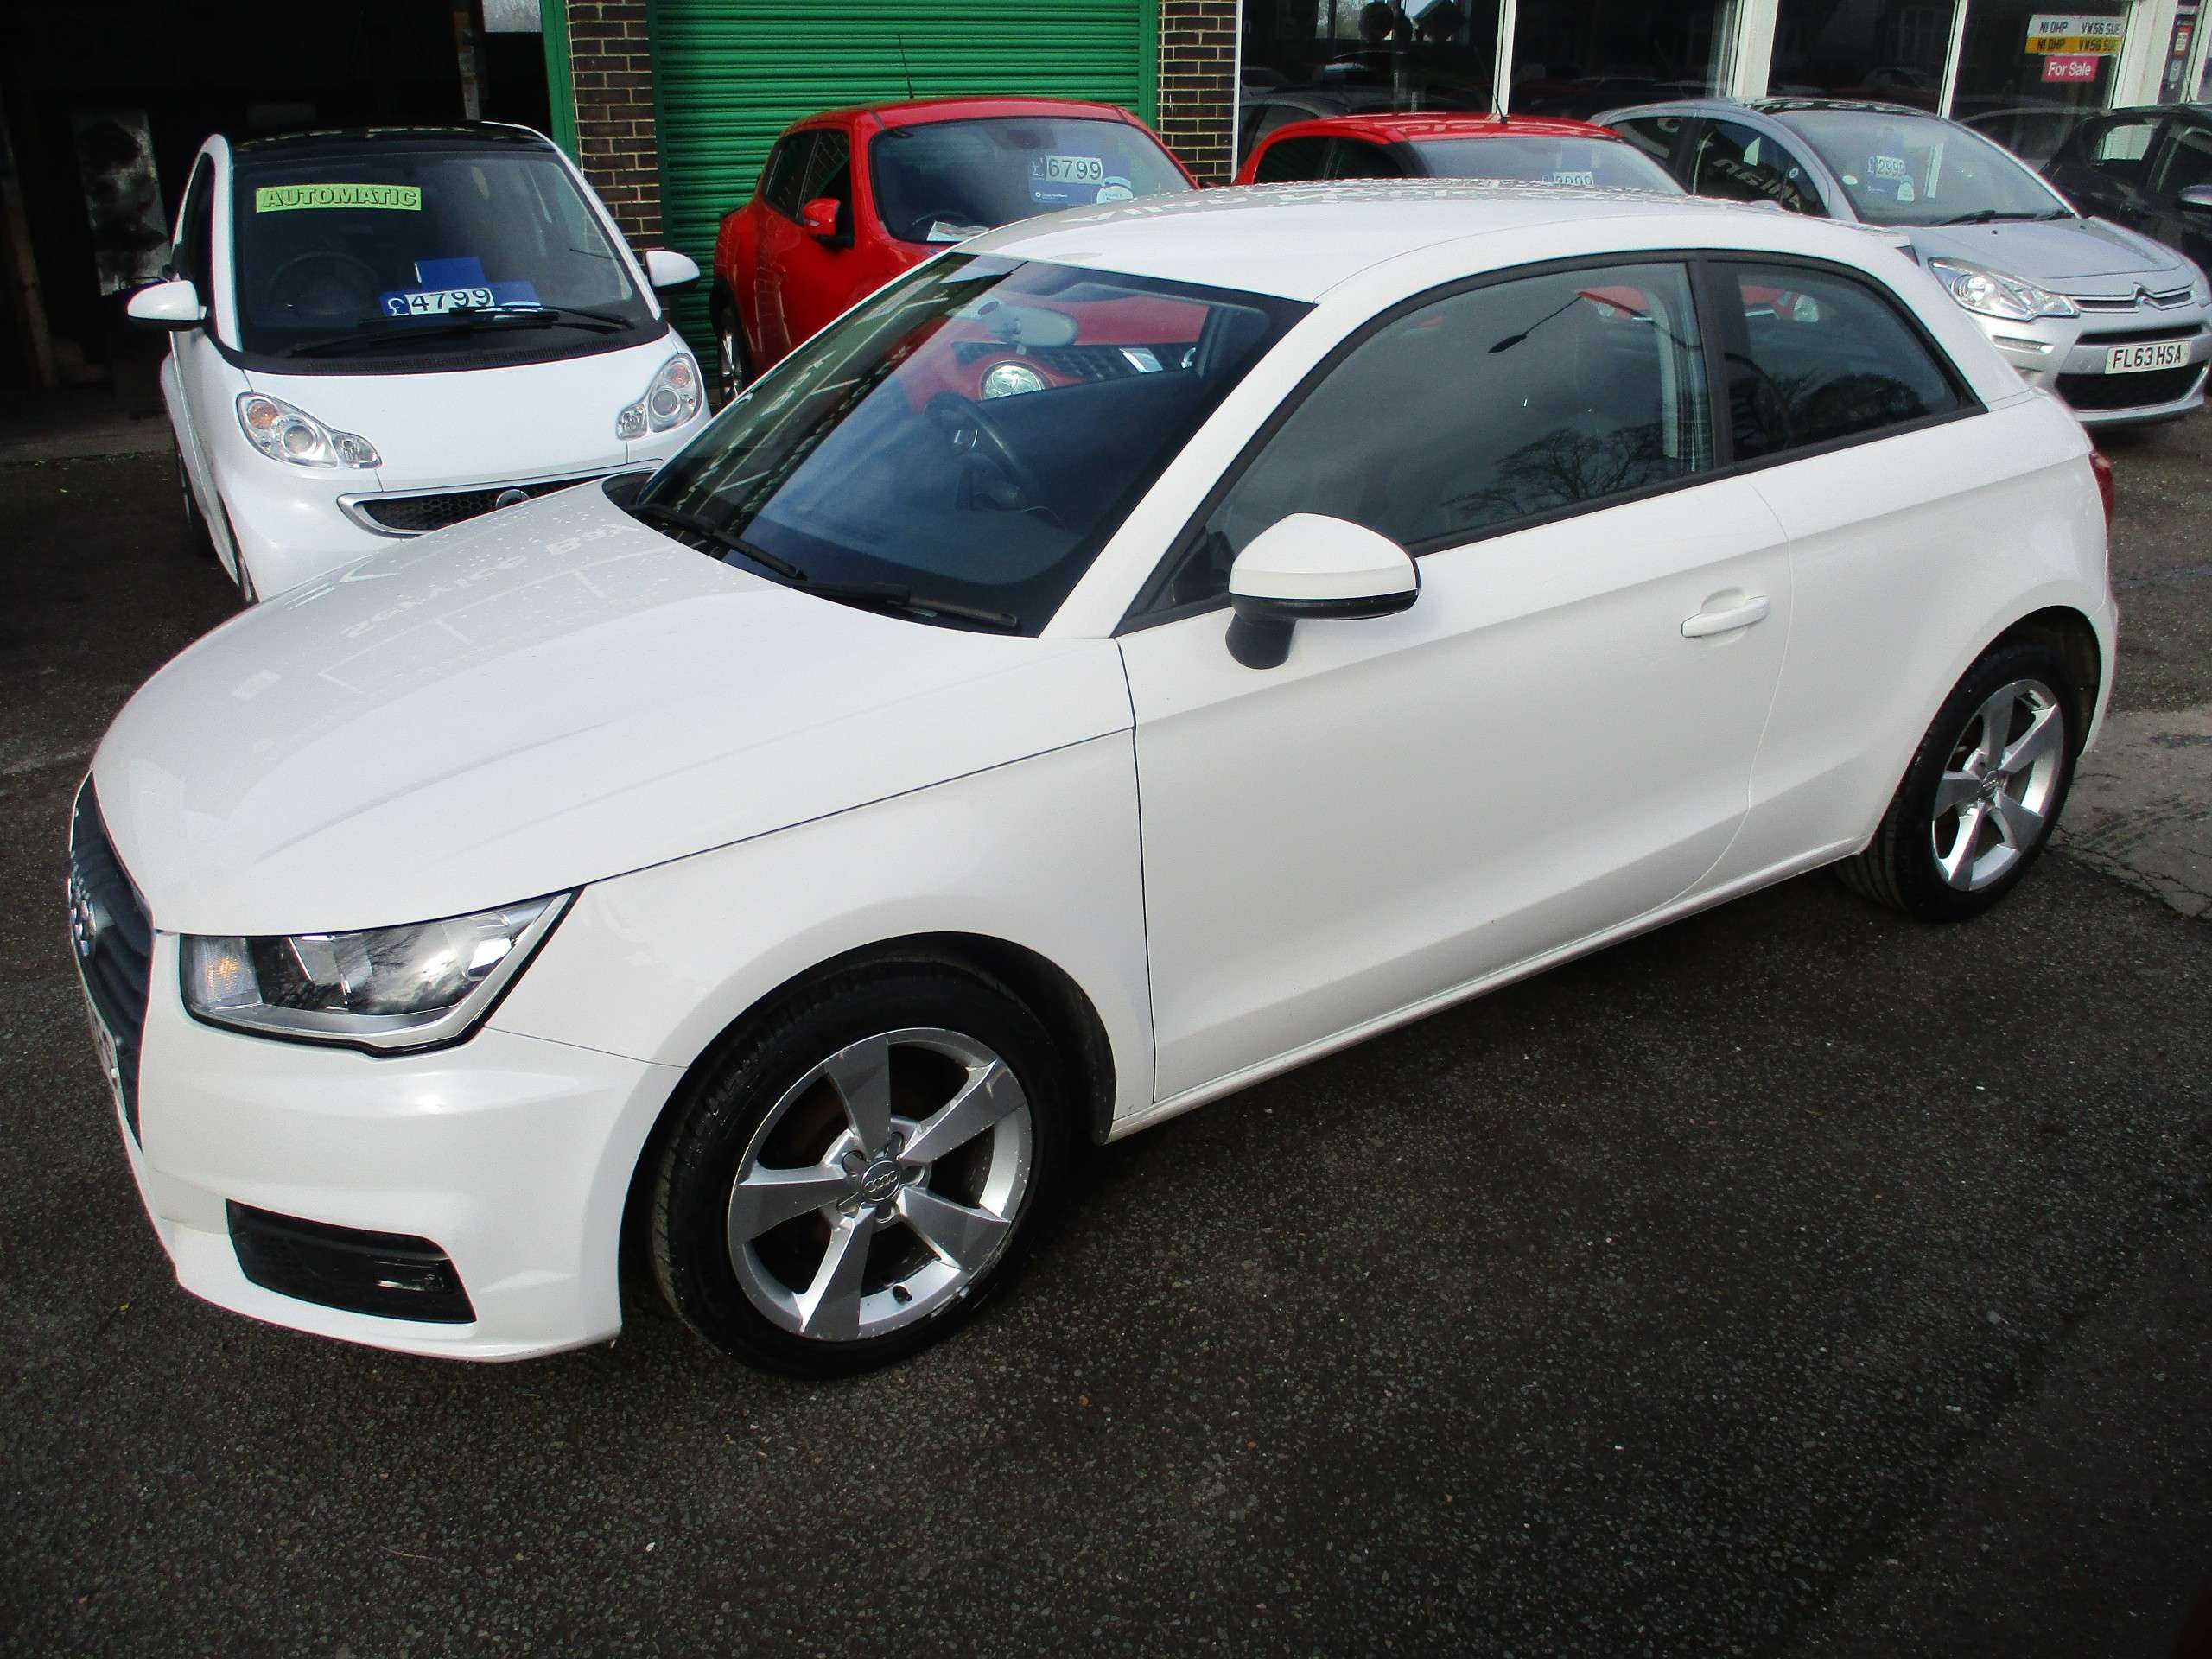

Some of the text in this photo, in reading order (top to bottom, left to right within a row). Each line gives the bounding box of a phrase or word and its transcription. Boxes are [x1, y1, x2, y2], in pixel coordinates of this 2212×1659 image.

[2047, 62, 2092, 77] For Sale
[262, 185, 418, 208] AUTOMATIC
[388, 289, 492, 316] £4799
[2112, 344, 2182, 369] FL63 HSA
